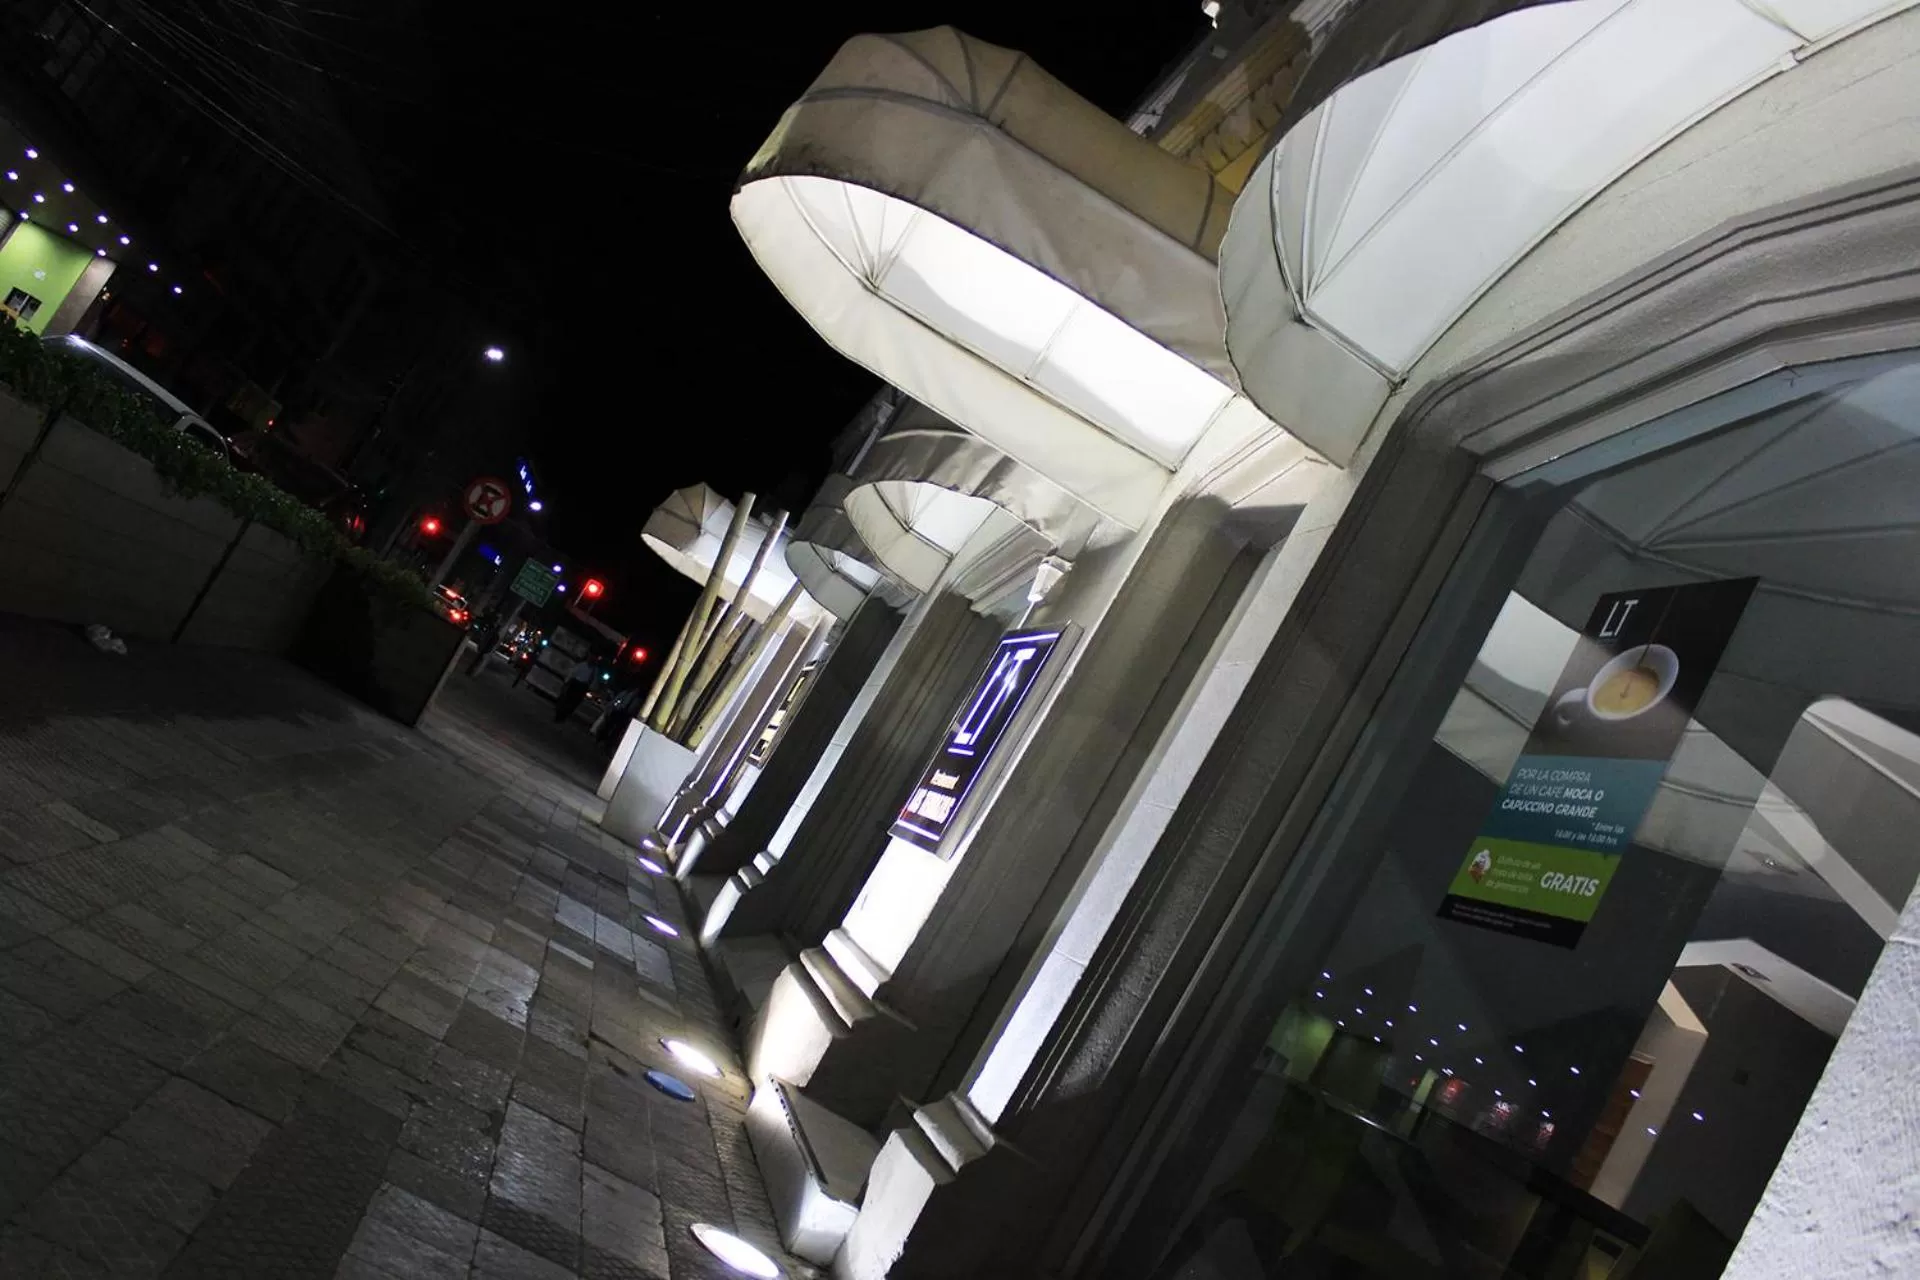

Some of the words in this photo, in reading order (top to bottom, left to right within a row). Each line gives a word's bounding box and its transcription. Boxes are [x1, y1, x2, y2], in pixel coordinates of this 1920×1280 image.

[1600, 599, 1638, 637] LT
[953, 647, 1037, 745] LT
[1517, 767, 1537, 780] POR
[1536, 769, 1549, 781] LA
[1550, 768, 1592, 782] COMPRA
[1563, 787, 1594, 801] MOCA
[1594, 789, 1605, 802] O
[1501, 798, 1555, 814] CAPUCCINO
[1555, 803, 1598, 818] GRANDE
[1540, 871, 1600, 897] GRATIS
